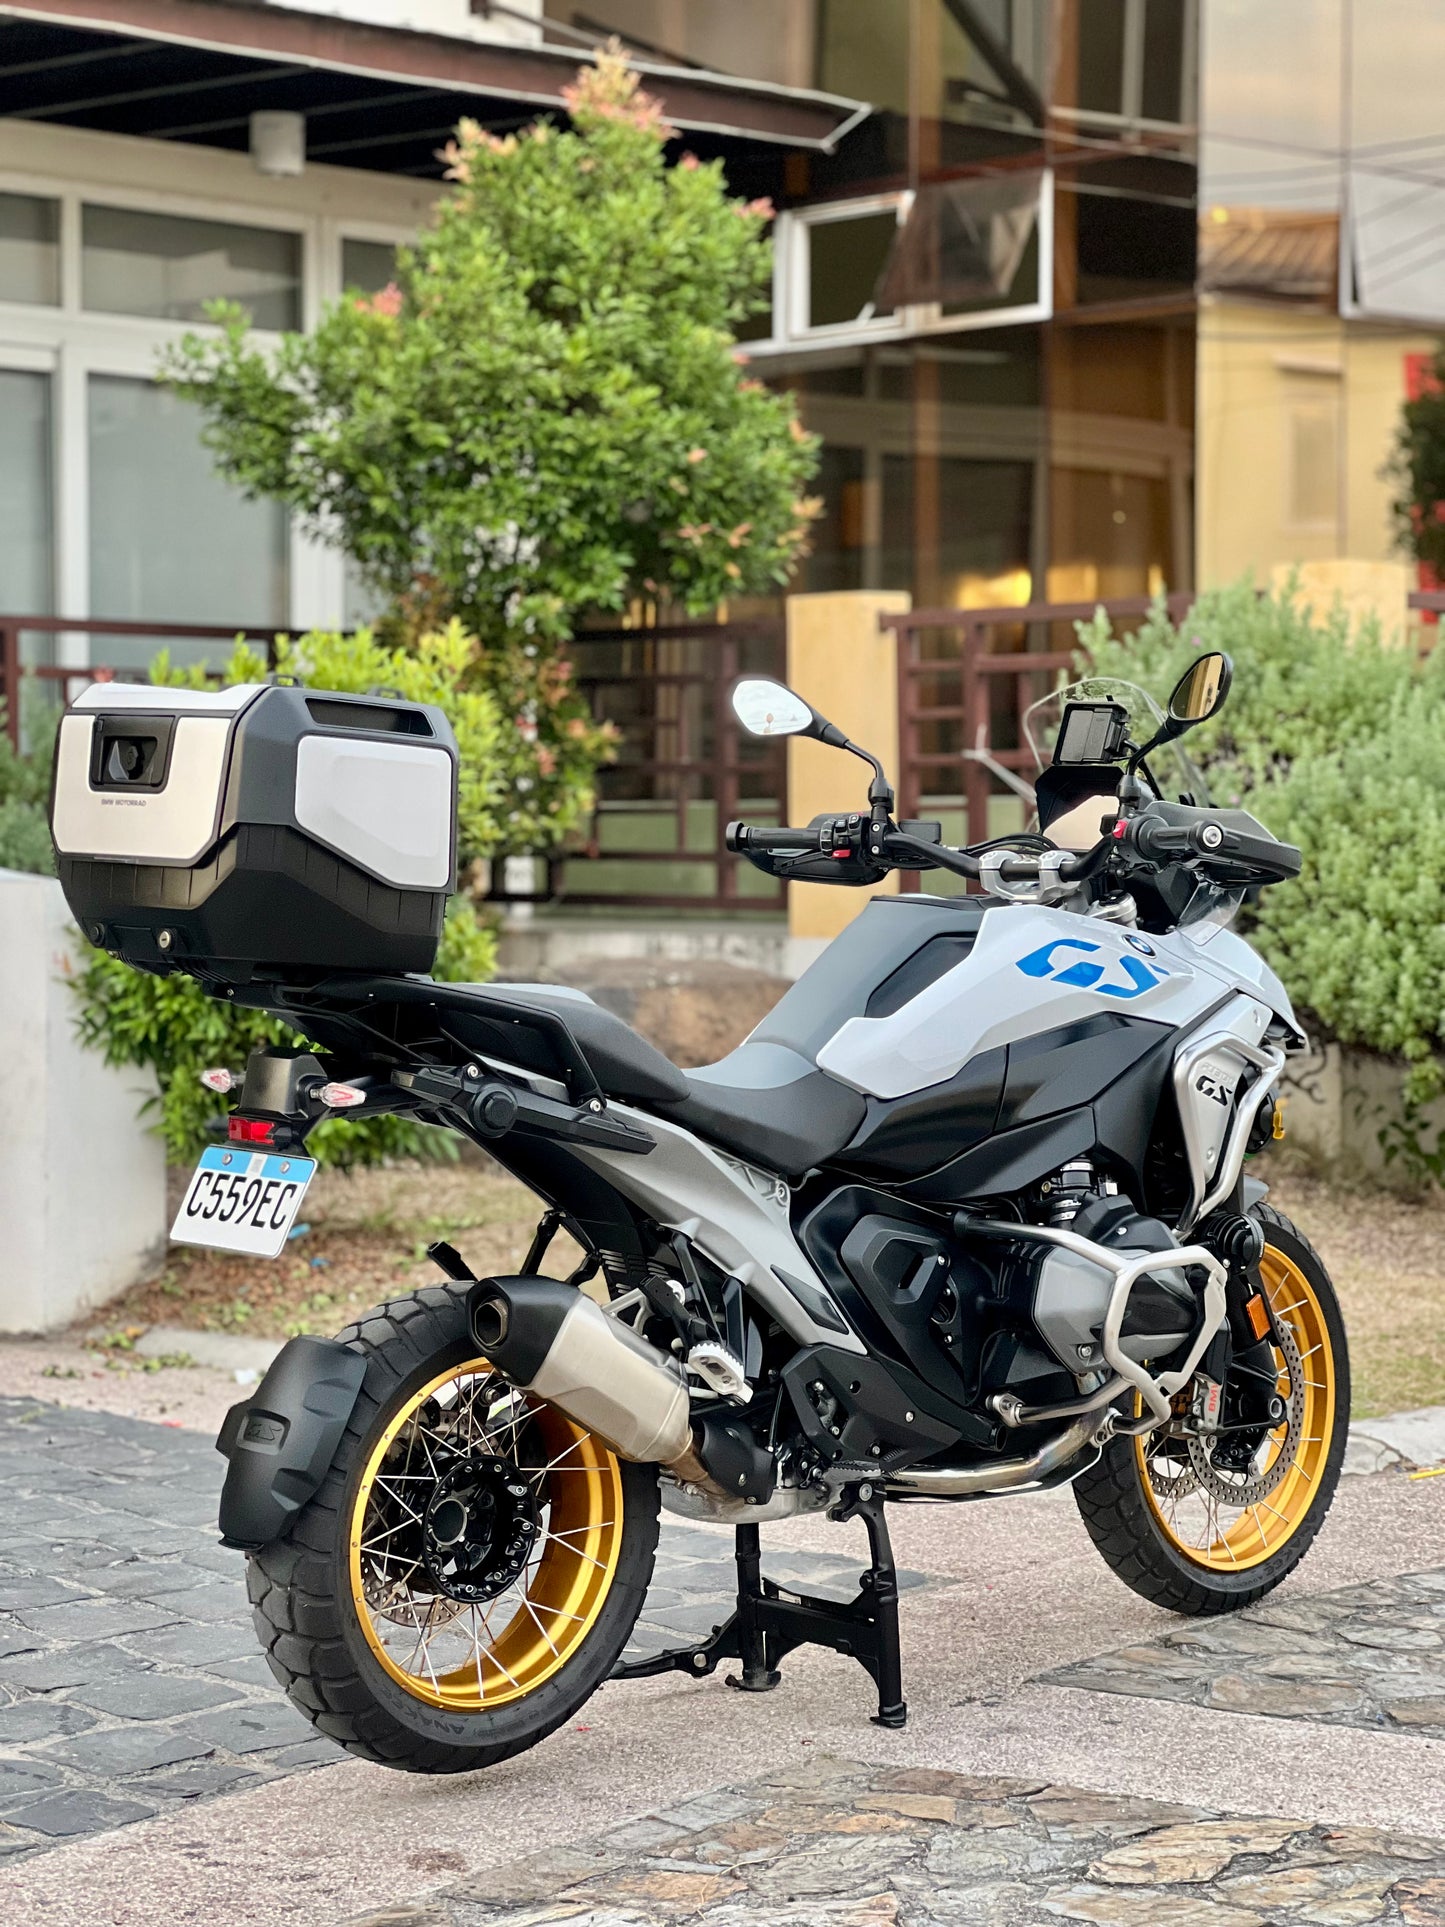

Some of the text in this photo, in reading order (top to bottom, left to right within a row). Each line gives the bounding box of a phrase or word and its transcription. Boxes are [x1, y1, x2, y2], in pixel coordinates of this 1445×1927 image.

[1015, 938, 1171, 999] GS
[1195, 1075, 1233, 1107] GS
[186, 1171, 298, 1230] C559EC
